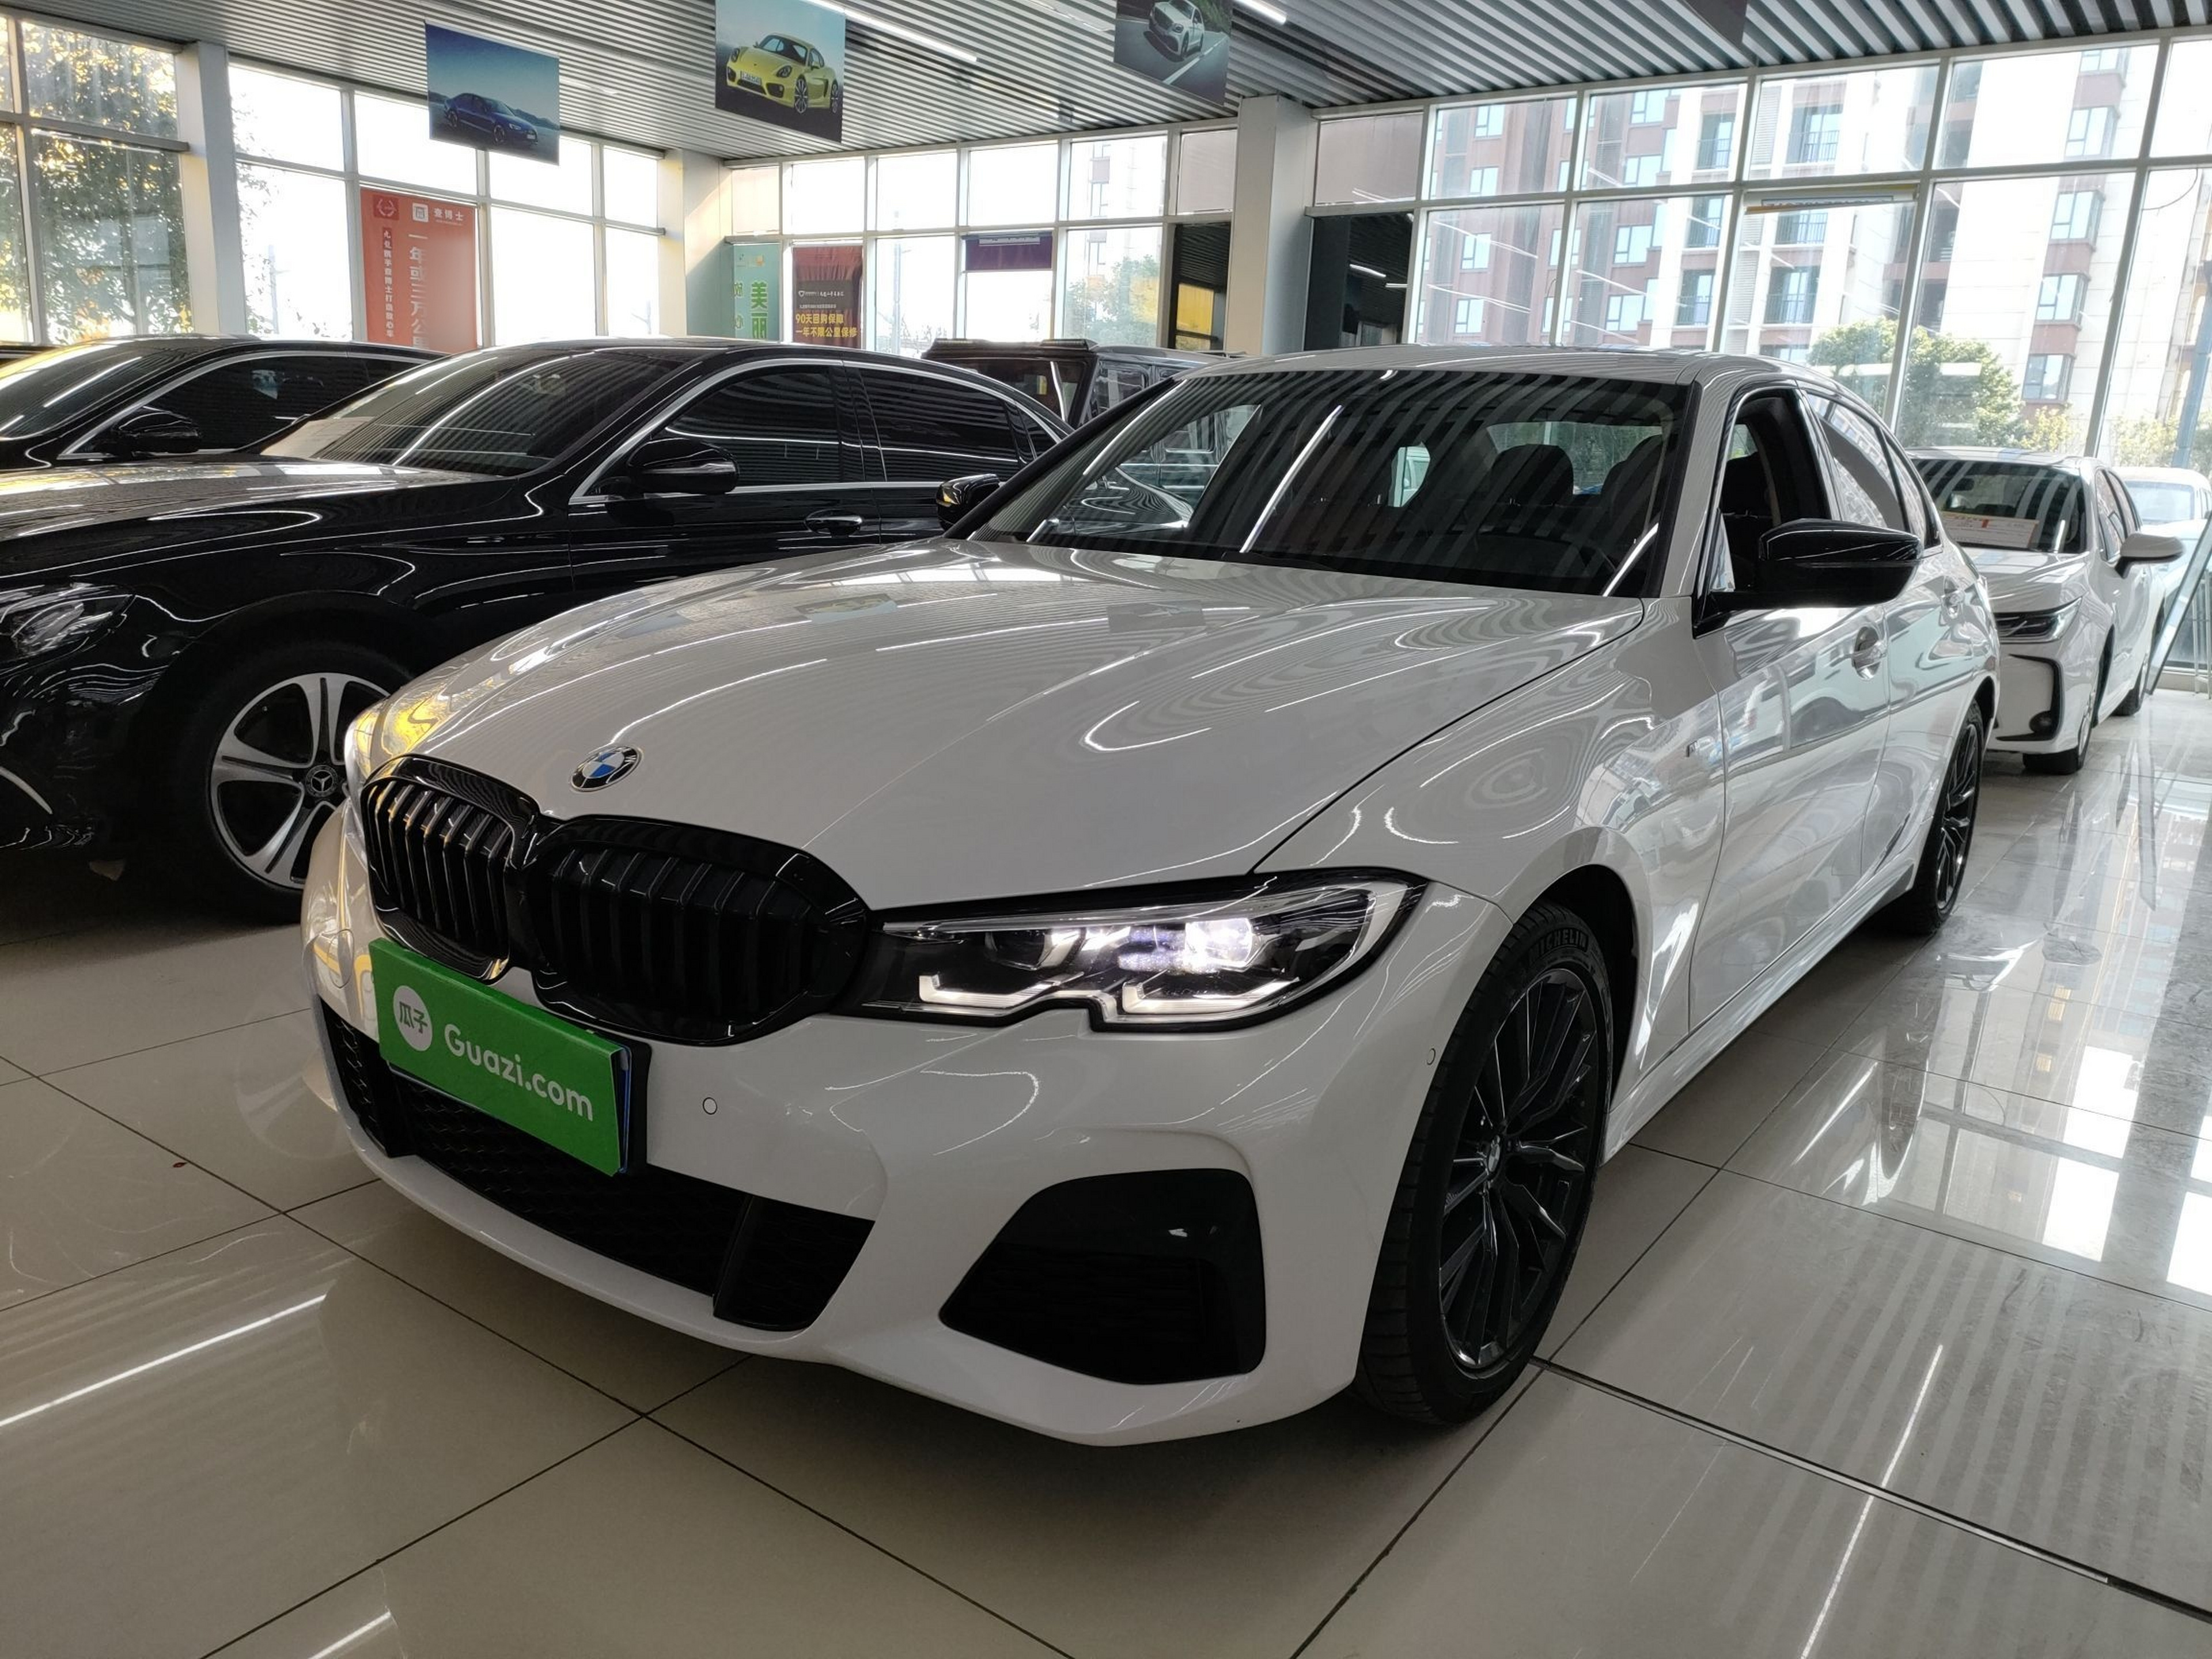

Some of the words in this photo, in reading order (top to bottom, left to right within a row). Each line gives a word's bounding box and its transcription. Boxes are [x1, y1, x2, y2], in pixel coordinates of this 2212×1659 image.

[433, 208, 464, 222] 查博士
[408, 233, 430, 349] 一年或三万公里
[751, 282, 768, 338] 美丽
[1528, 928, 1587, 966] MICHELIN
[399, 1001, 428, 1034] 瓜子
[444, 1024, 593, 1122] Guazi.com
